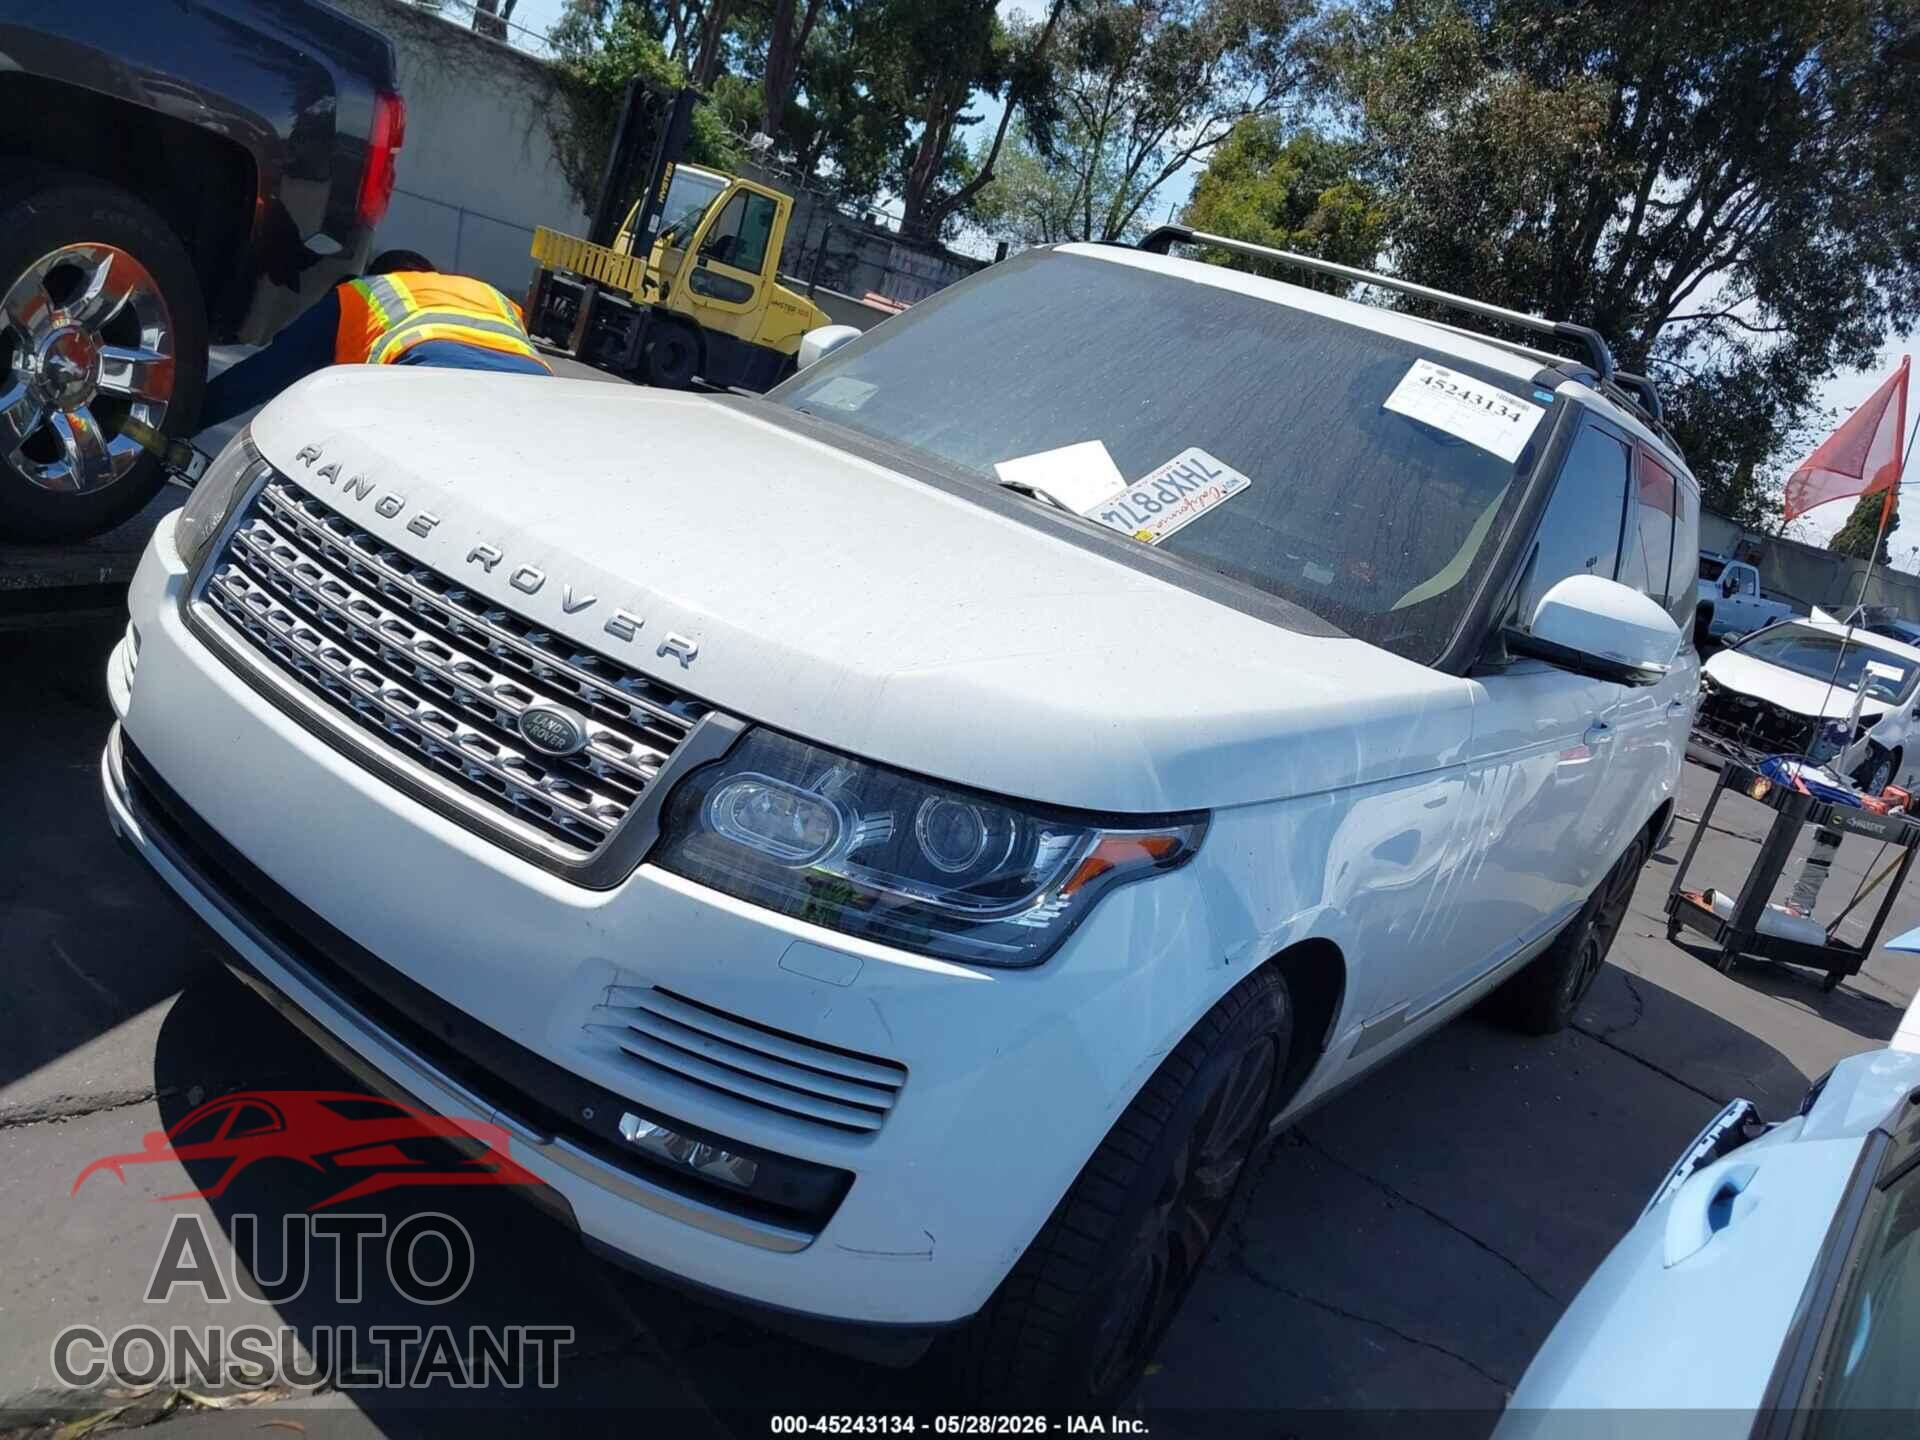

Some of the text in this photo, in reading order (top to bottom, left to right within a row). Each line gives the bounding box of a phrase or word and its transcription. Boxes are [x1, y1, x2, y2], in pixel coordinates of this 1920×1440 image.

[1419, 375, 1522, 423] 45243134
[1099, 457, 1223, 530] 7HXP874
[296, 443, 700, 670] RANGE ROVER
[532, 724, 567, 749] ROVER
